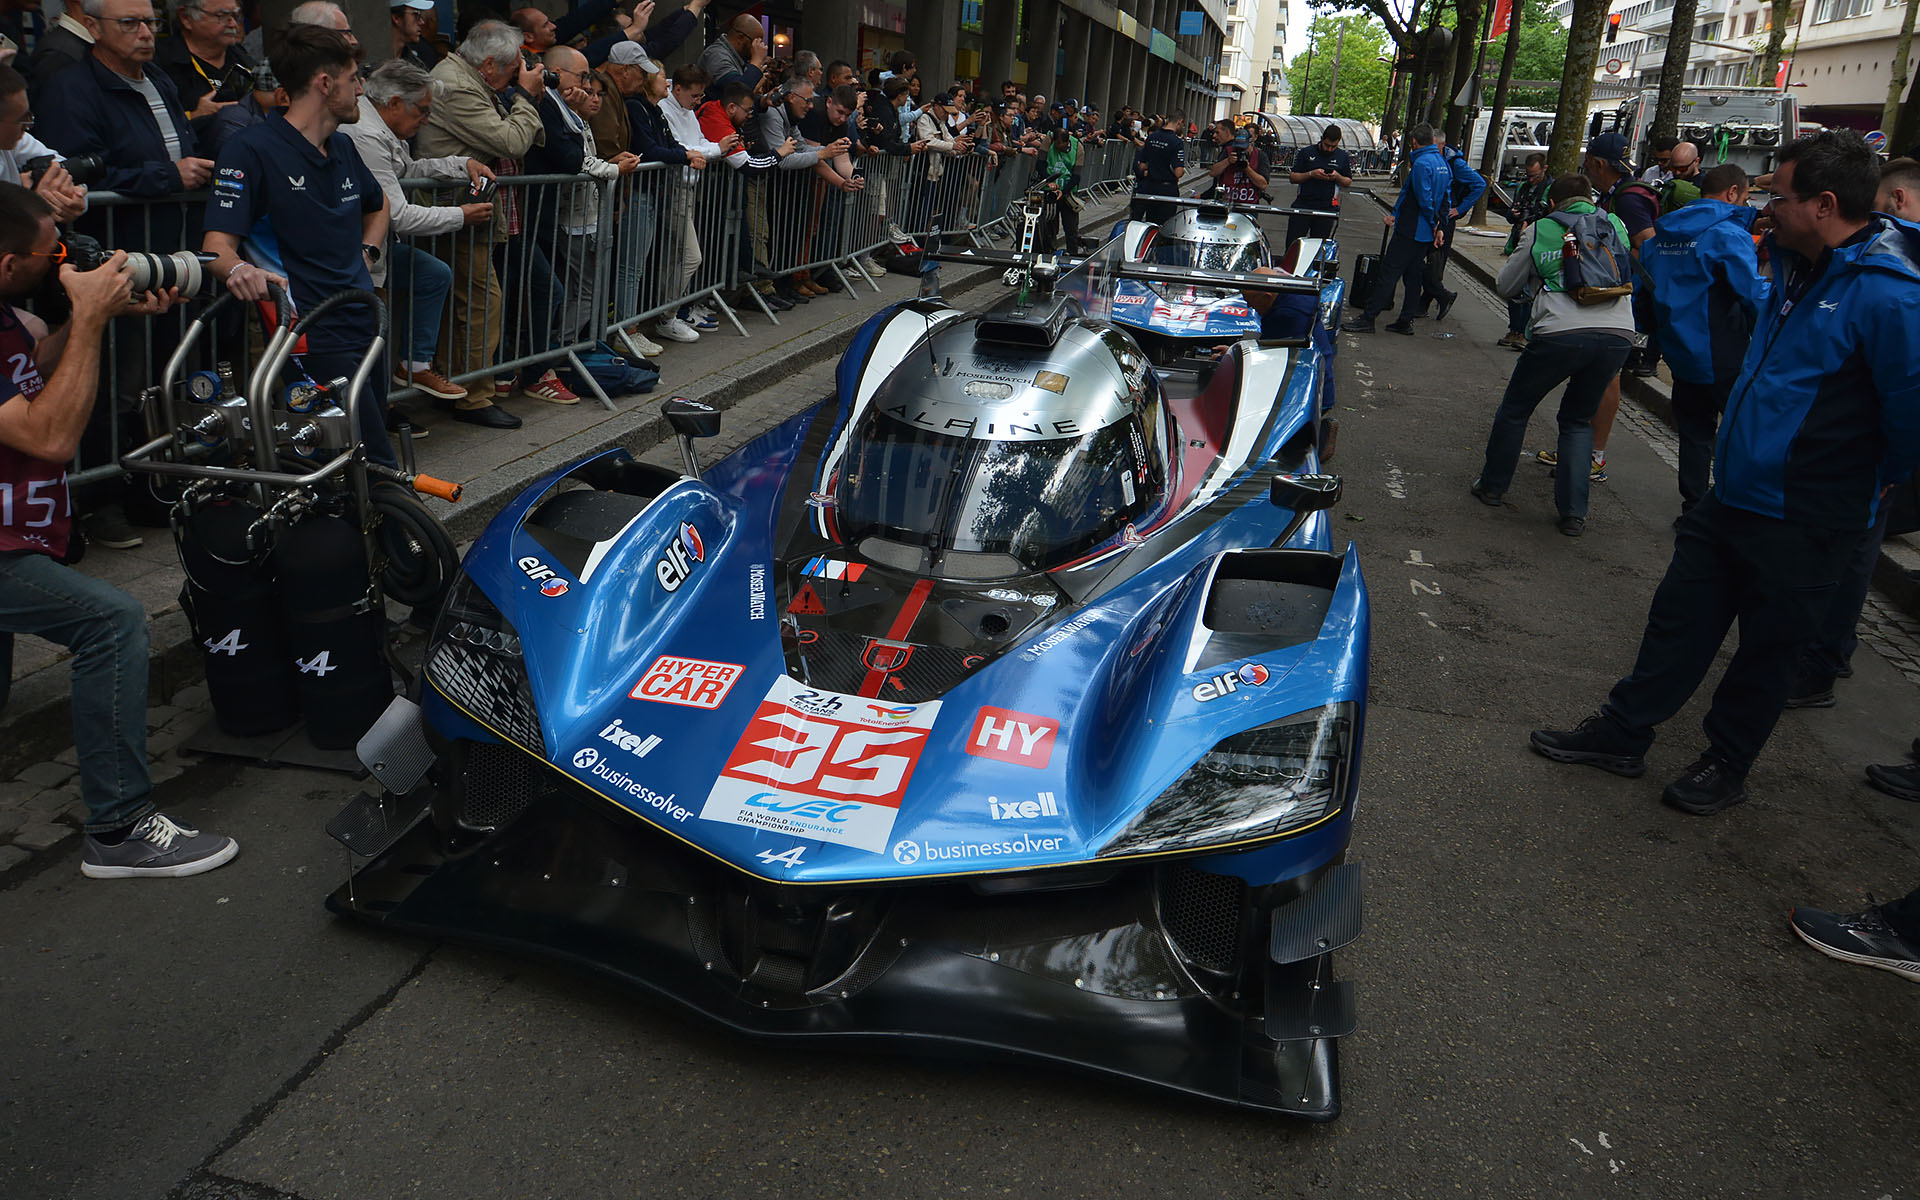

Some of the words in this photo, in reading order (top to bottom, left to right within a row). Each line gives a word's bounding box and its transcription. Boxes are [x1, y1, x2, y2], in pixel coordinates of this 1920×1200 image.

[1224, 306, 1246, 315] HY
[887, 404, 1080, 436] ALPINE
[518, 556, 558, 582] elf
[657, 537, 692, 592] elf
[655, 659, 735, 681] HYPER
[641, 673, 724, 704] CAR
[1192, 671, 1243, 702] elf
[860, 717, 910, 727] TotalEnergies
[976, 716, 1051, 756] HY
[598, 719, 663, 758] ixell
[730, 713, 925, 797] 35
[592, 758, 694, 823] businessolver
[739, 809, 753, 818] FIA
[756, 813, 788, 825] WORLD
[790, 820, 844, 835] ENDURANCE
[745, 792, 862, 823] WEC
[988, 792, 1058, 821] ixell
[737, 815, 805, 833] CHAMPIONSHIP
[926, 832, 1063, 862] businessolver
